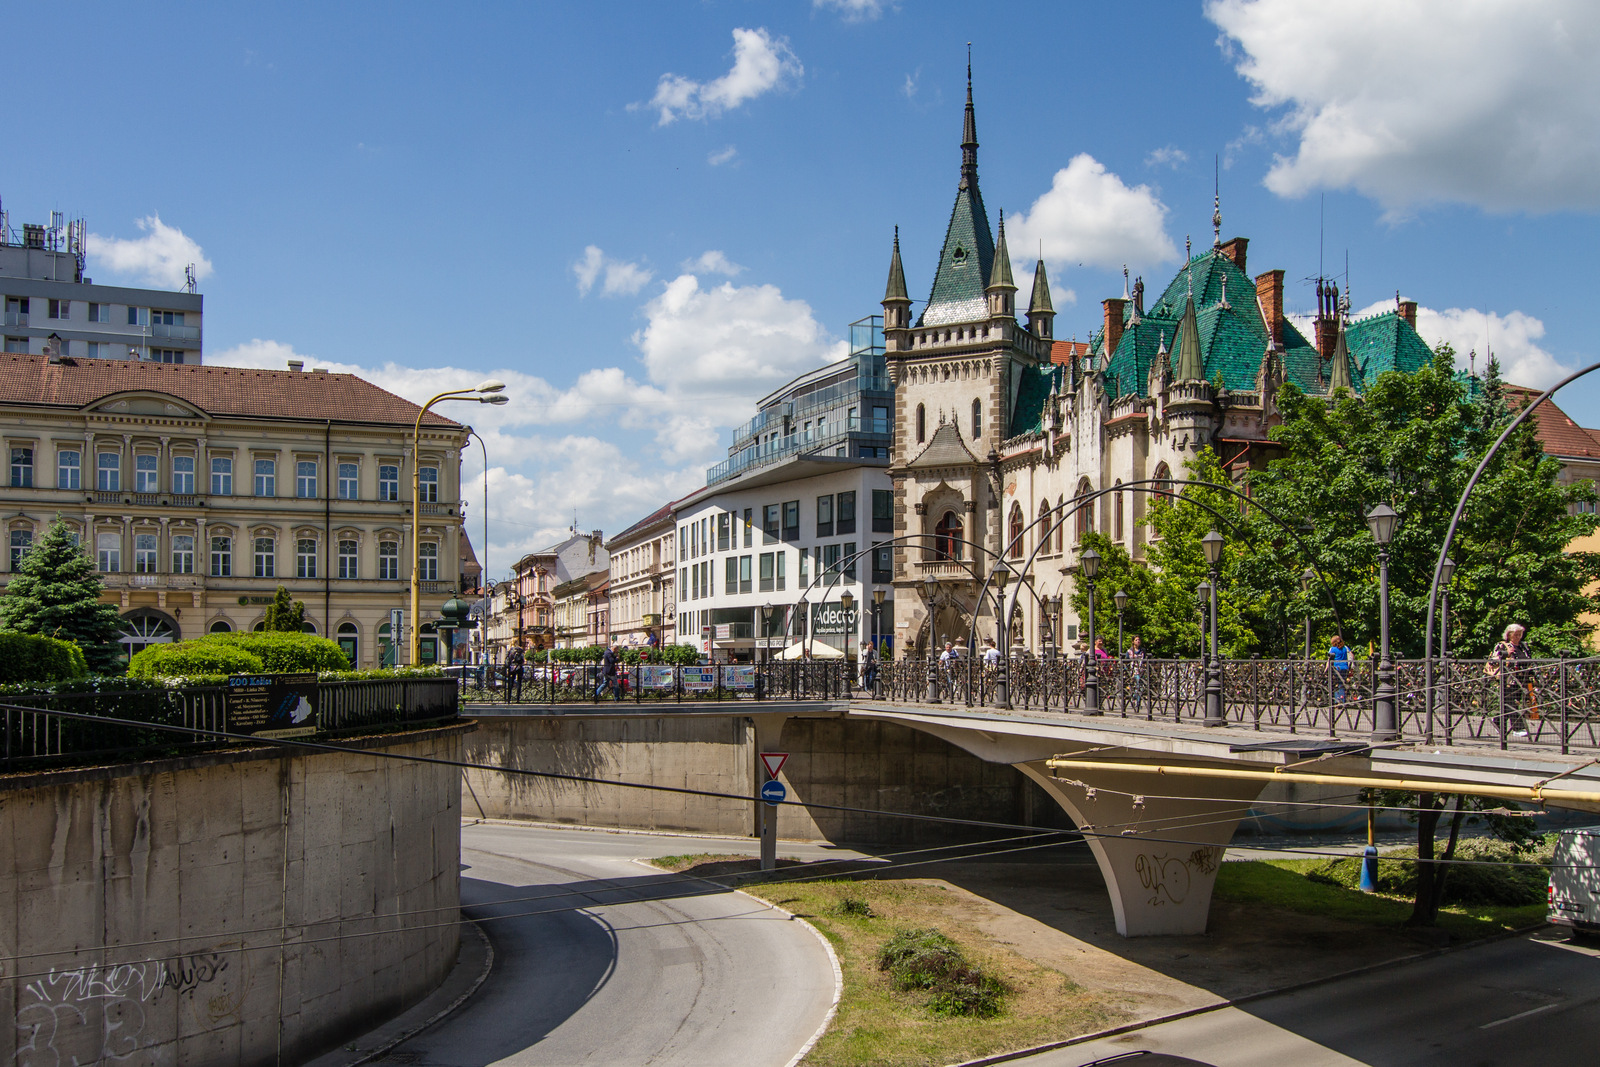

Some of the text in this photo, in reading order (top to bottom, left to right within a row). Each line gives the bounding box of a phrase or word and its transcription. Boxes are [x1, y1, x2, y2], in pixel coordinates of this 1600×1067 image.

[814, 605, 855, 624] Adecco
[229, 677, 272, 687] ZOO Košice
